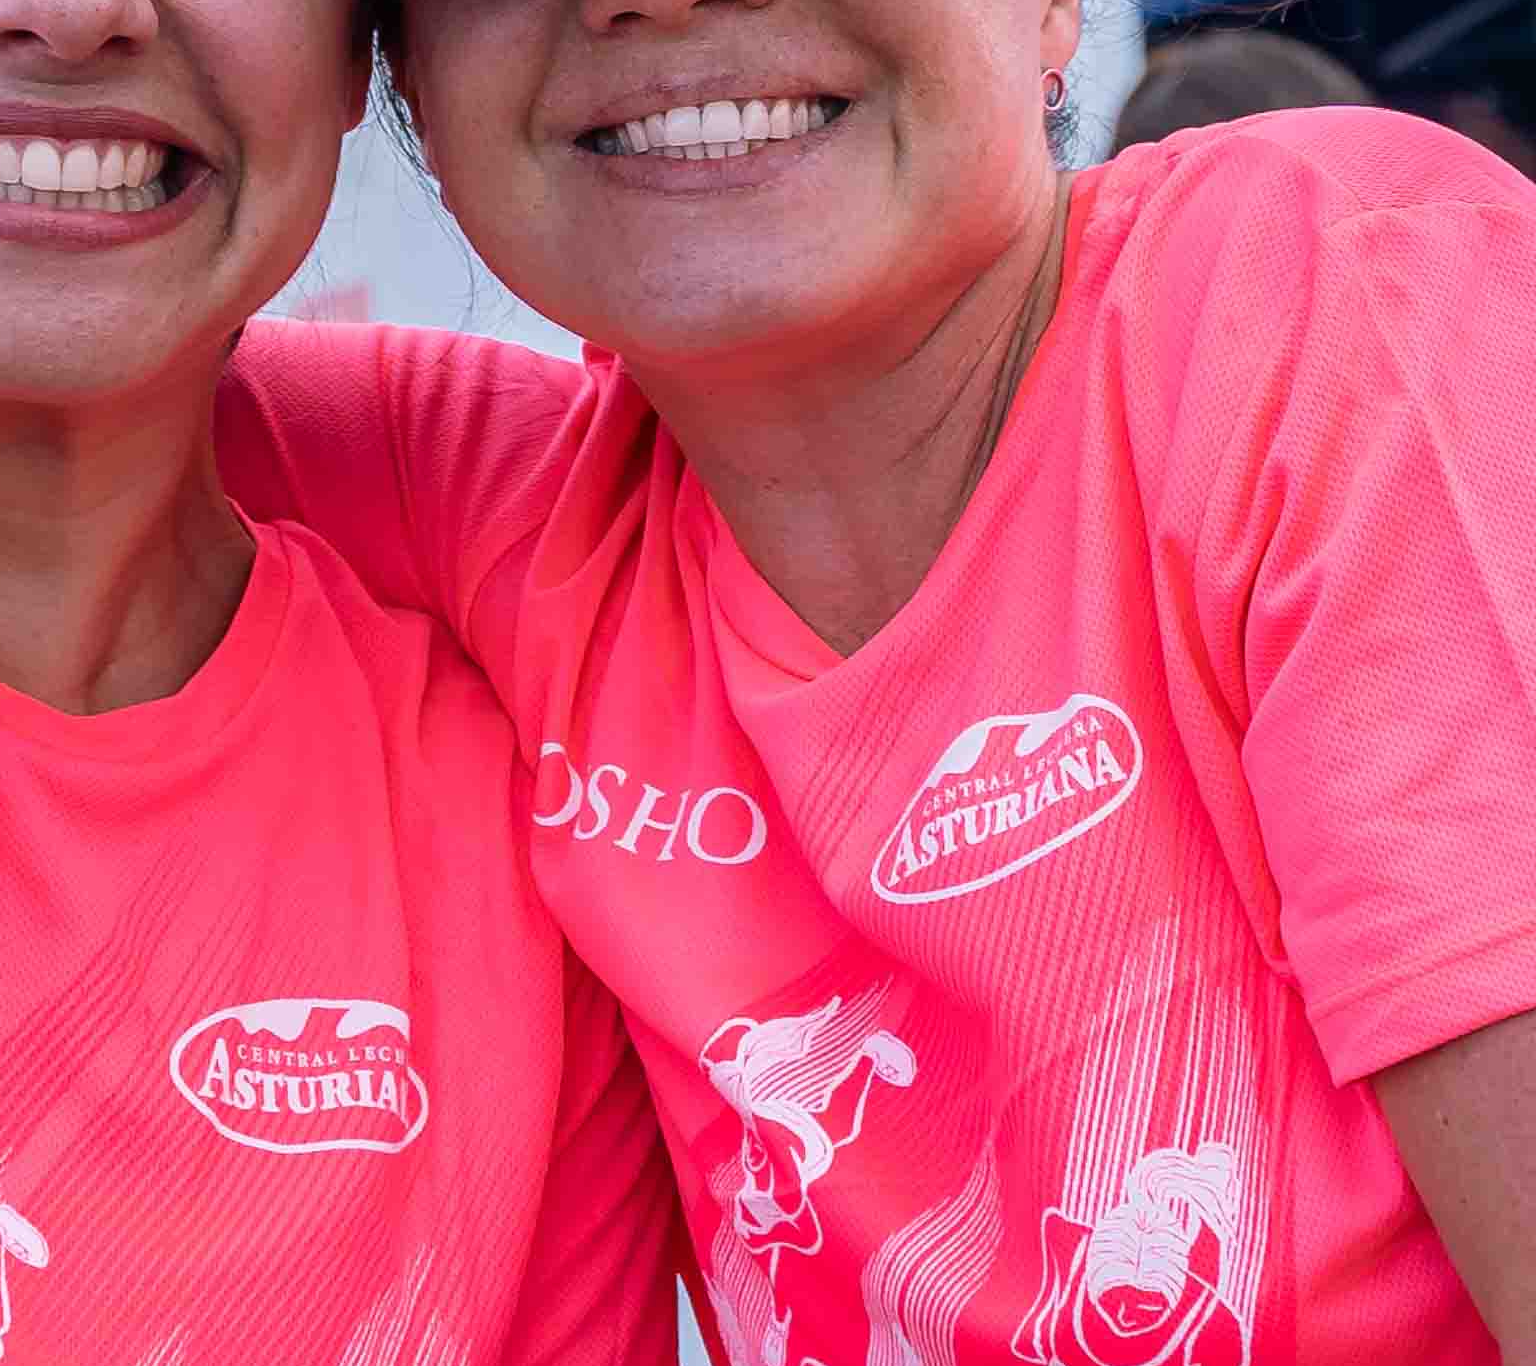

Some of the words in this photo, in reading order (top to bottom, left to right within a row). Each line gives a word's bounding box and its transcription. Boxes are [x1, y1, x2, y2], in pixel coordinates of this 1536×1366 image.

[888, 739, 1127, 889] ASTURIANA
[923, 772, 1013, 816] CENTRAL
[237, 1044, 337, 1068] CENTRAL
